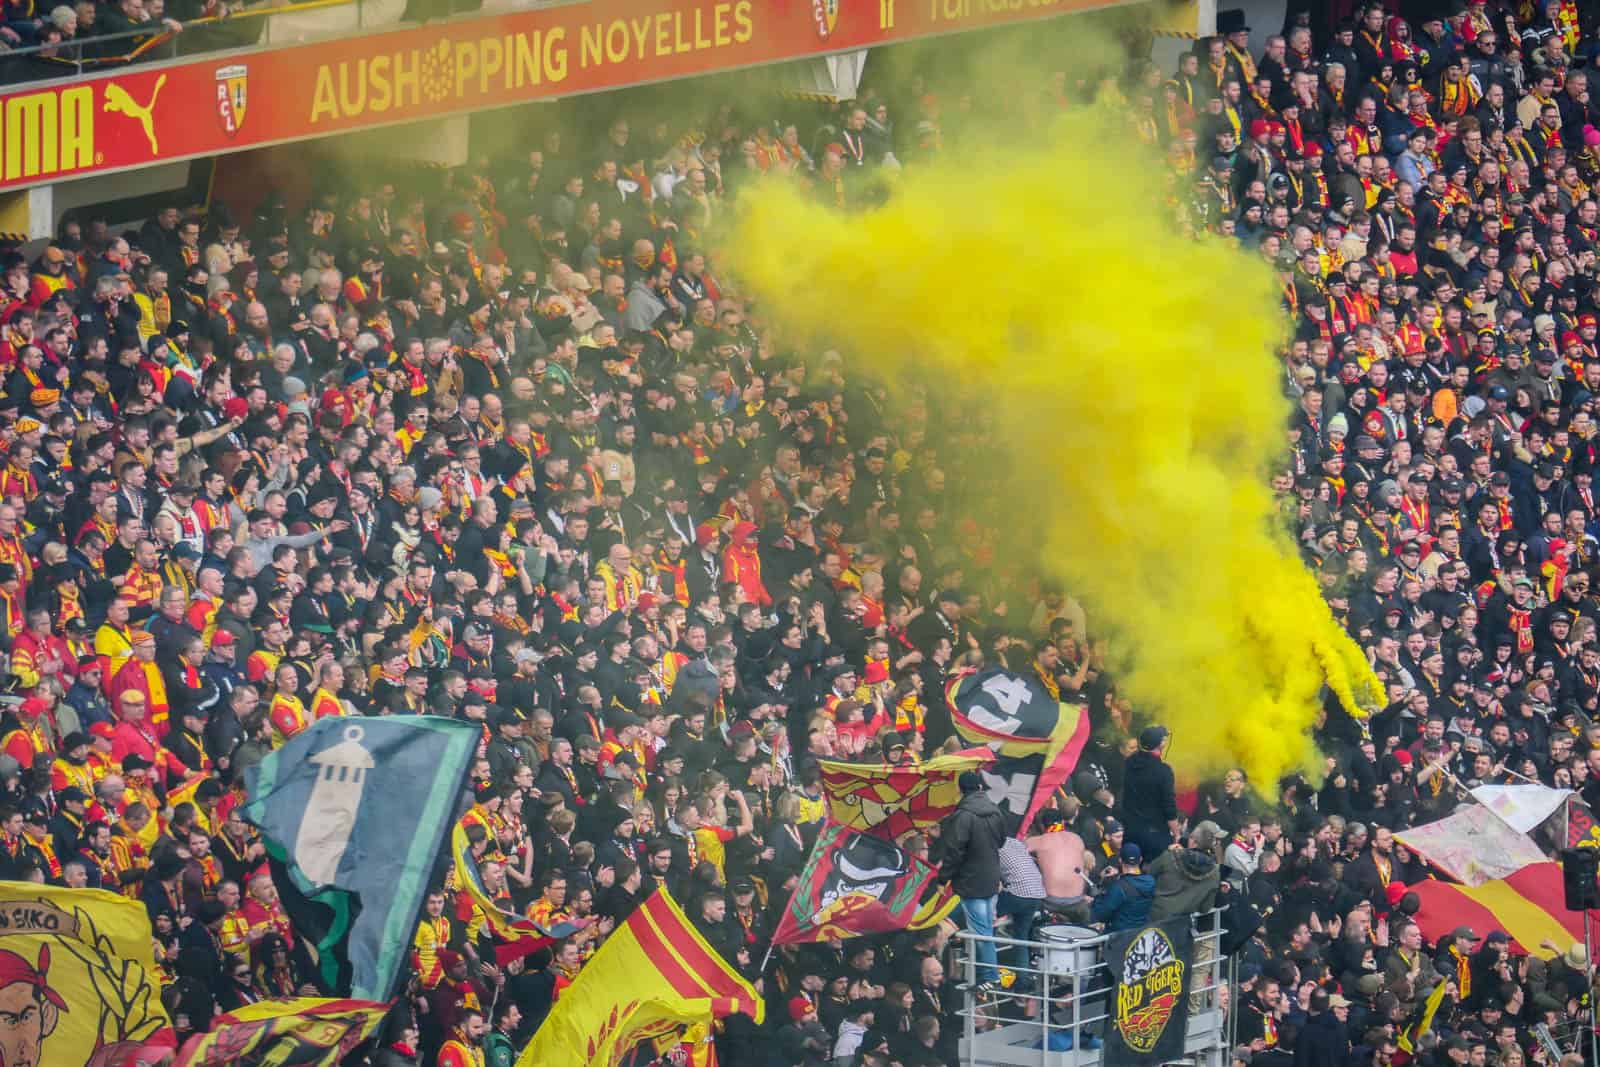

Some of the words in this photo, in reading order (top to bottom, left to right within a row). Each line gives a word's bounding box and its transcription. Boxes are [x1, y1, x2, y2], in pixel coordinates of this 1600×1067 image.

[580, 2, 752, 68] NOYELLES
[0, 86, 94, 180] MA
[1117, 983, 1143, 1024] RED
[1143, 960, 1184, 996] TIGERS
